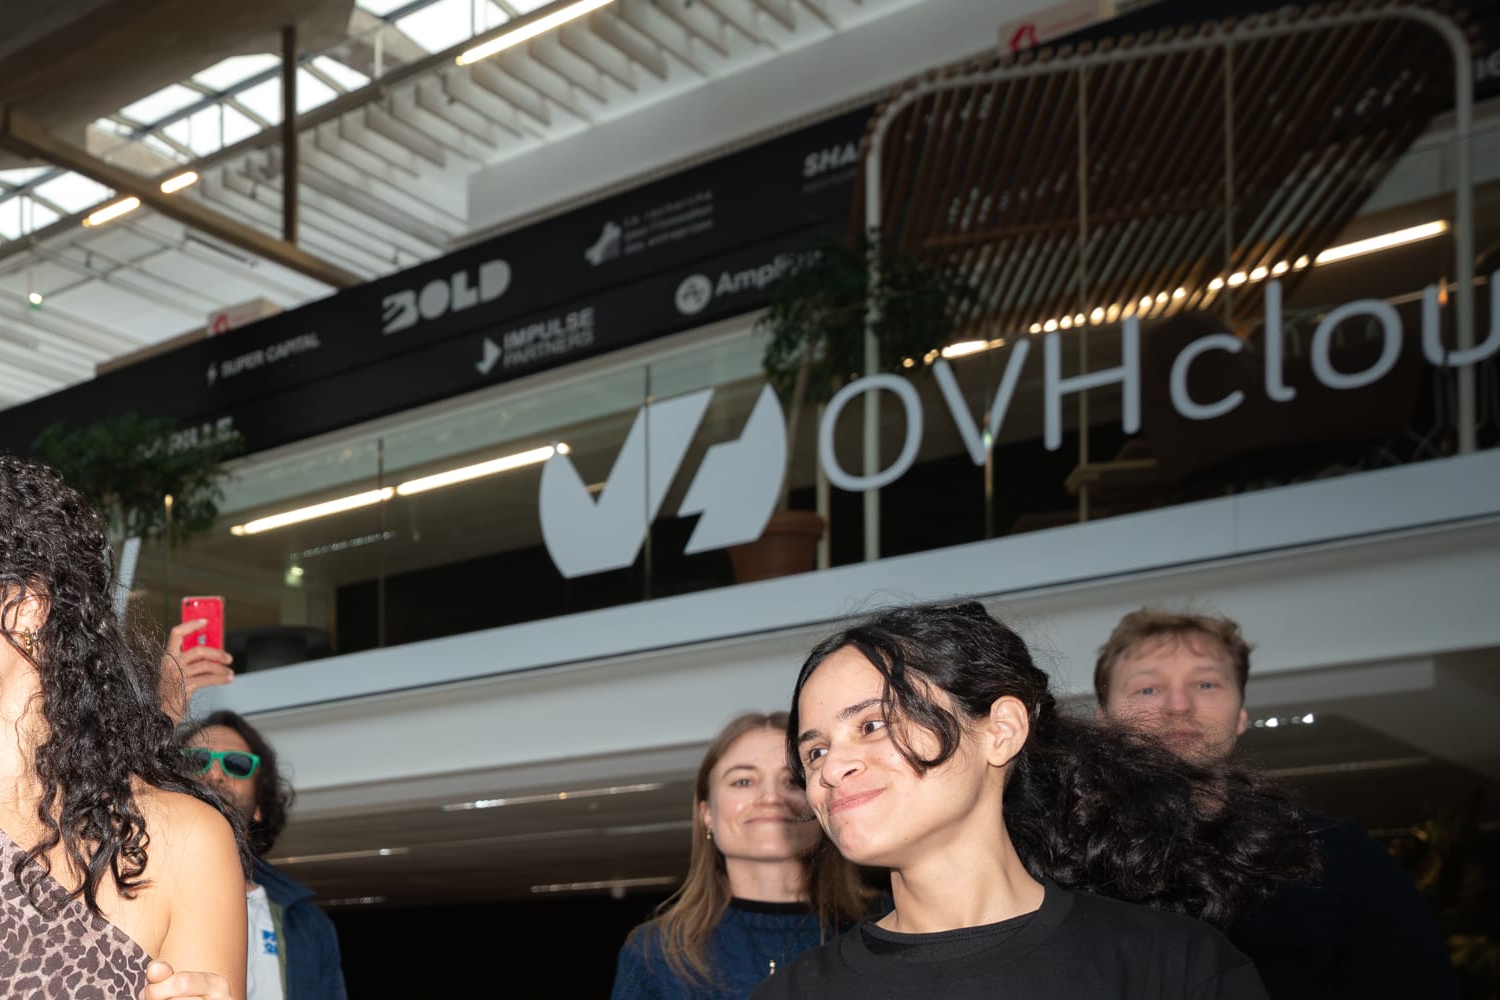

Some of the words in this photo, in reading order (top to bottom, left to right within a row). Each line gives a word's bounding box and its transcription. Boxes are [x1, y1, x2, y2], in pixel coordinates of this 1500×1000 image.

[381, 258, 513, 336] BOLD
[503, 306, 596, 349] IMPULSE
[220, 348, 265, 378] SUPER
[266, 332, 321, 363] CAPITAL
[503, 331, 596, 370] PARTNERS
